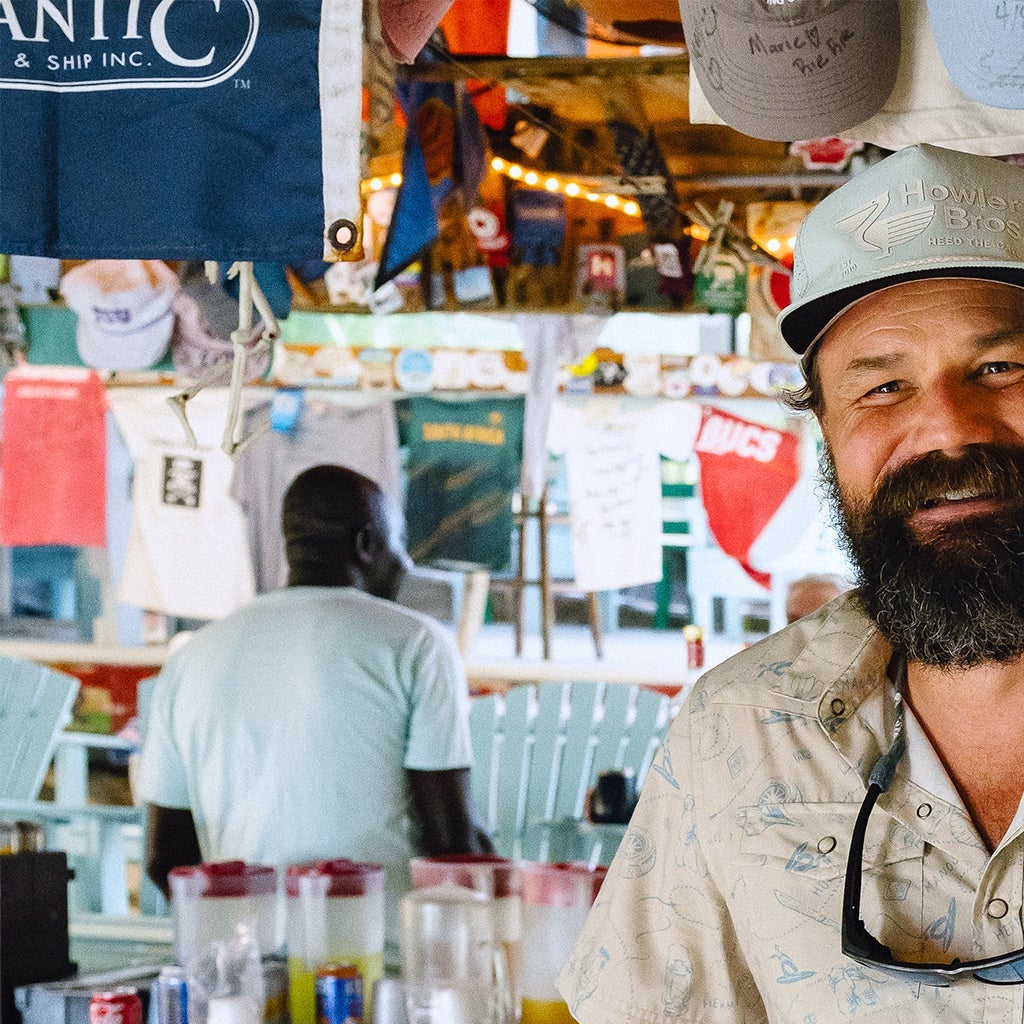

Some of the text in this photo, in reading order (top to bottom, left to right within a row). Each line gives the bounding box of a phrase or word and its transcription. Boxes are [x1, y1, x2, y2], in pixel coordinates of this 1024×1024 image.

[14, 51, 152, 71] & SHIP INC.
[904, 179, 1022, 213] Howler
[944, 205, 1022, 240] Bros
[928, 237, 963, 247] HEED
[967, 238, 990, 249] THE
